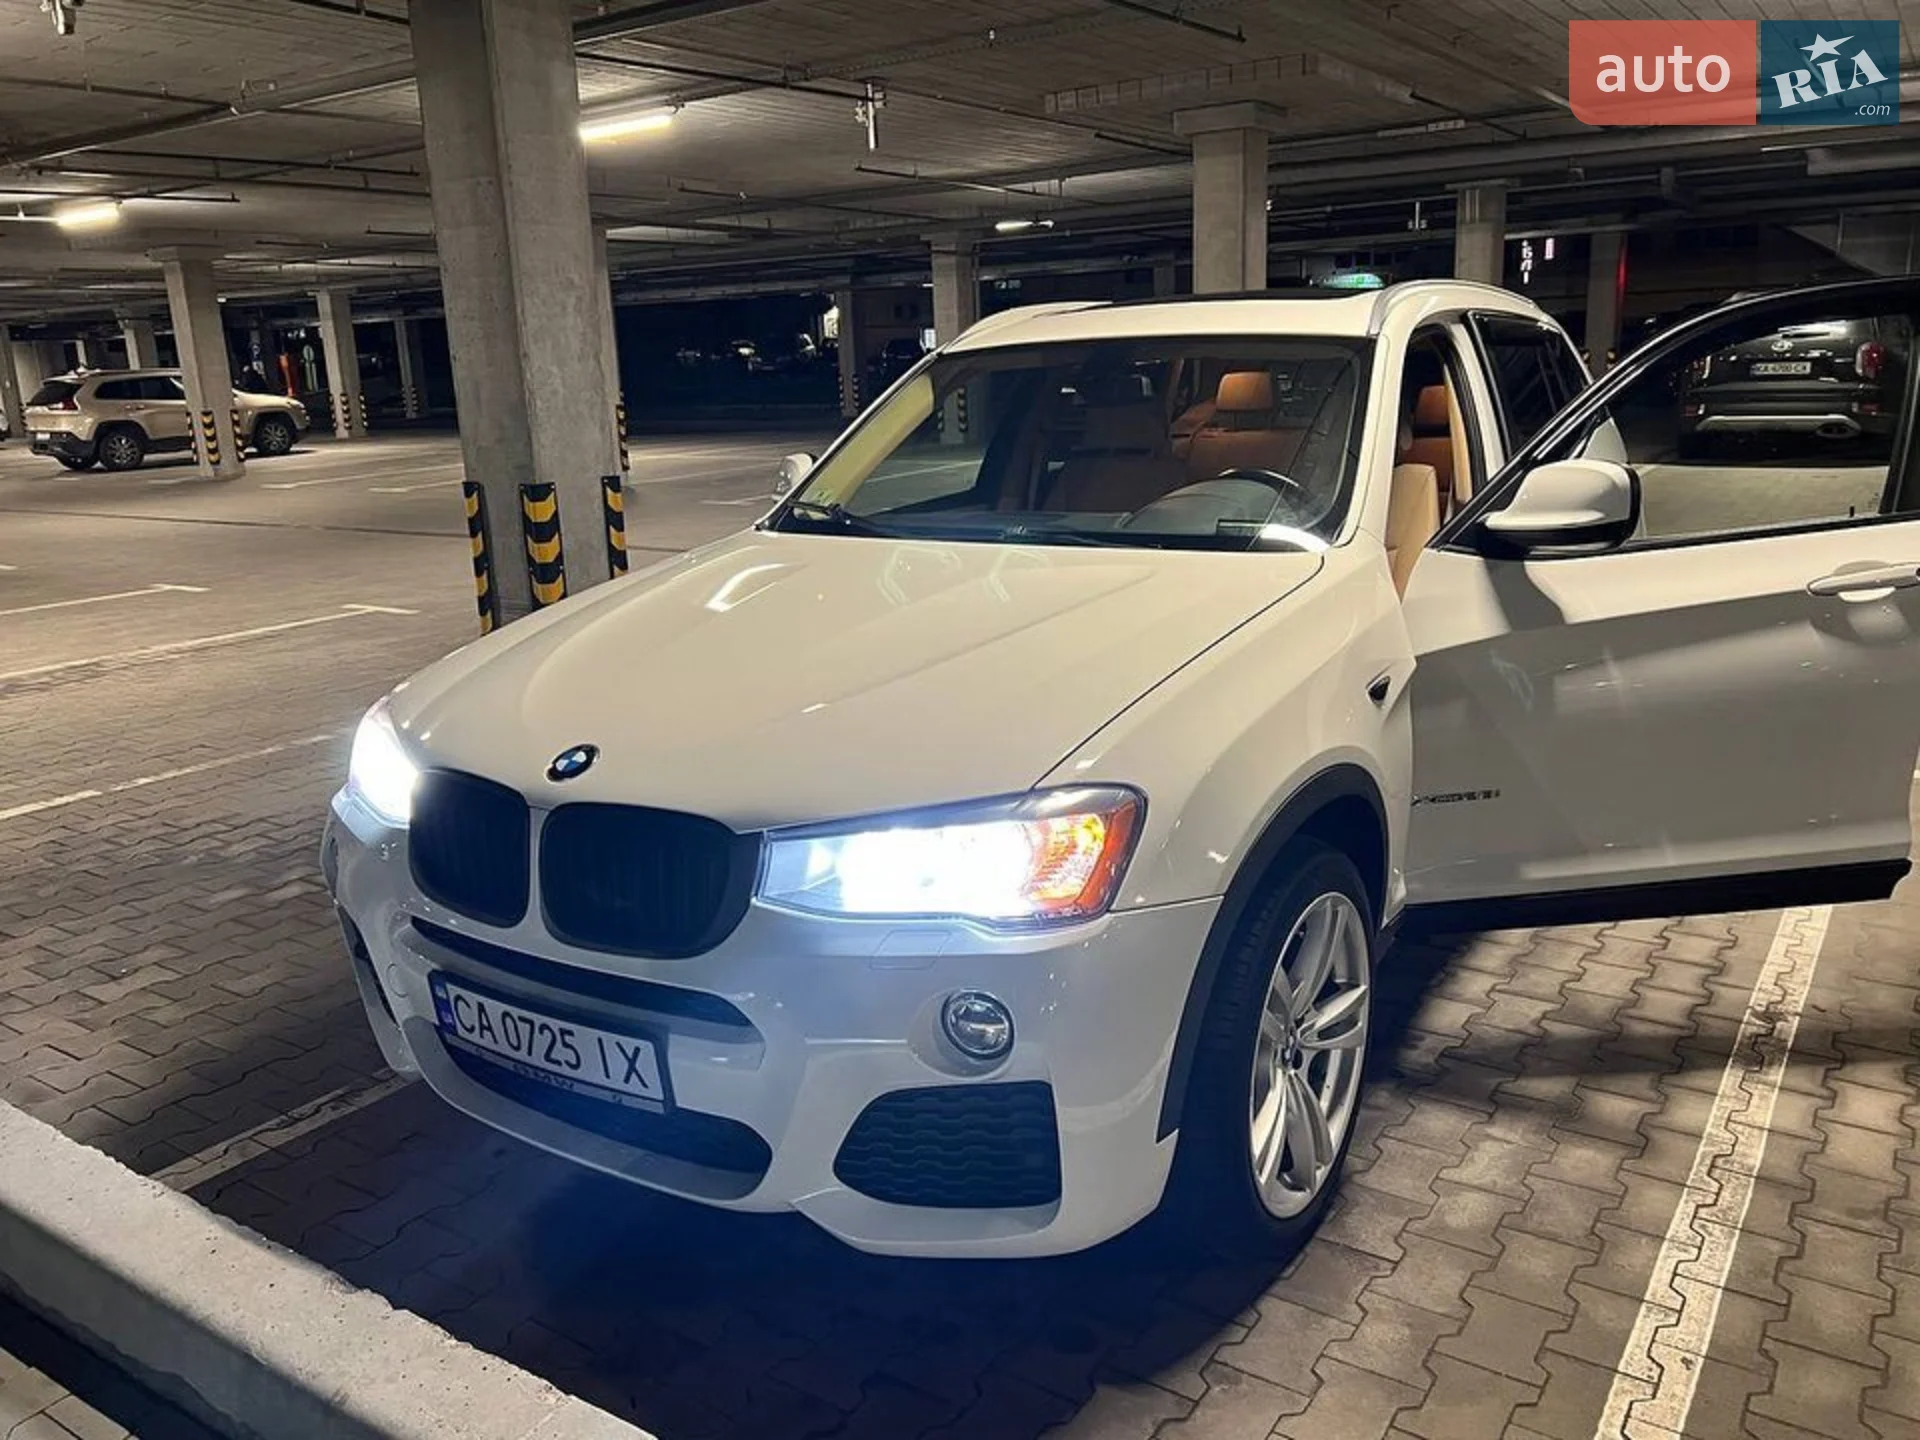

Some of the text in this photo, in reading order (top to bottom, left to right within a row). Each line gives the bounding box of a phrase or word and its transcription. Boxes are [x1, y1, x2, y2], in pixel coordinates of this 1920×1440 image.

[453, 995, 498, 1045] CA
[502, 1011, 581, 1071] 0725
[597, 1037, 649, 1089] IX
